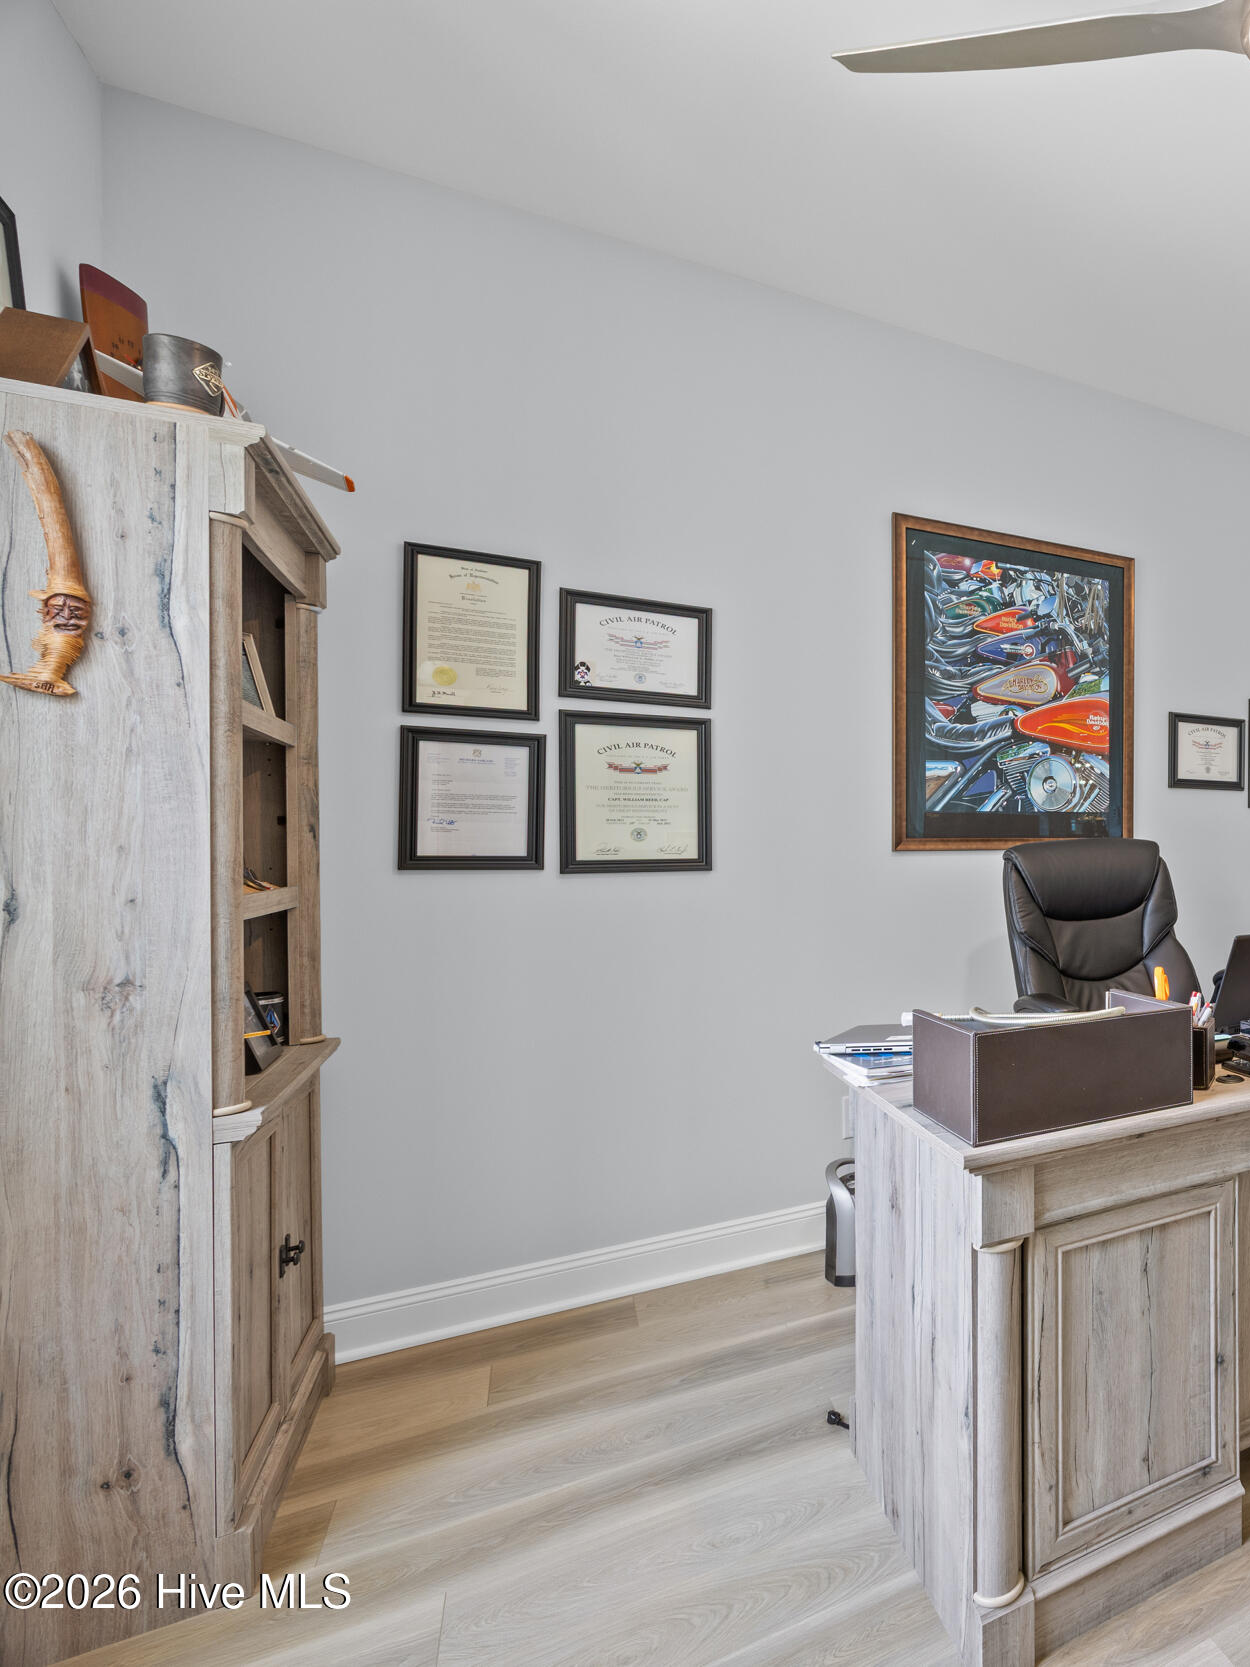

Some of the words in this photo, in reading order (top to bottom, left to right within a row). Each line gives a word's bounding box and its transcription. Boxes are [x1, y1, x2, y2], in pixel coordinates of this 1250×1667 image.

[599, 616, 624, 627] CIVIL
[645, 617, 678, 635] PATROL
[597, 743, 623, 755] CIVIL
[624, 741, 641, 749] AIR
[643, 742, 677, 758] PATROL
